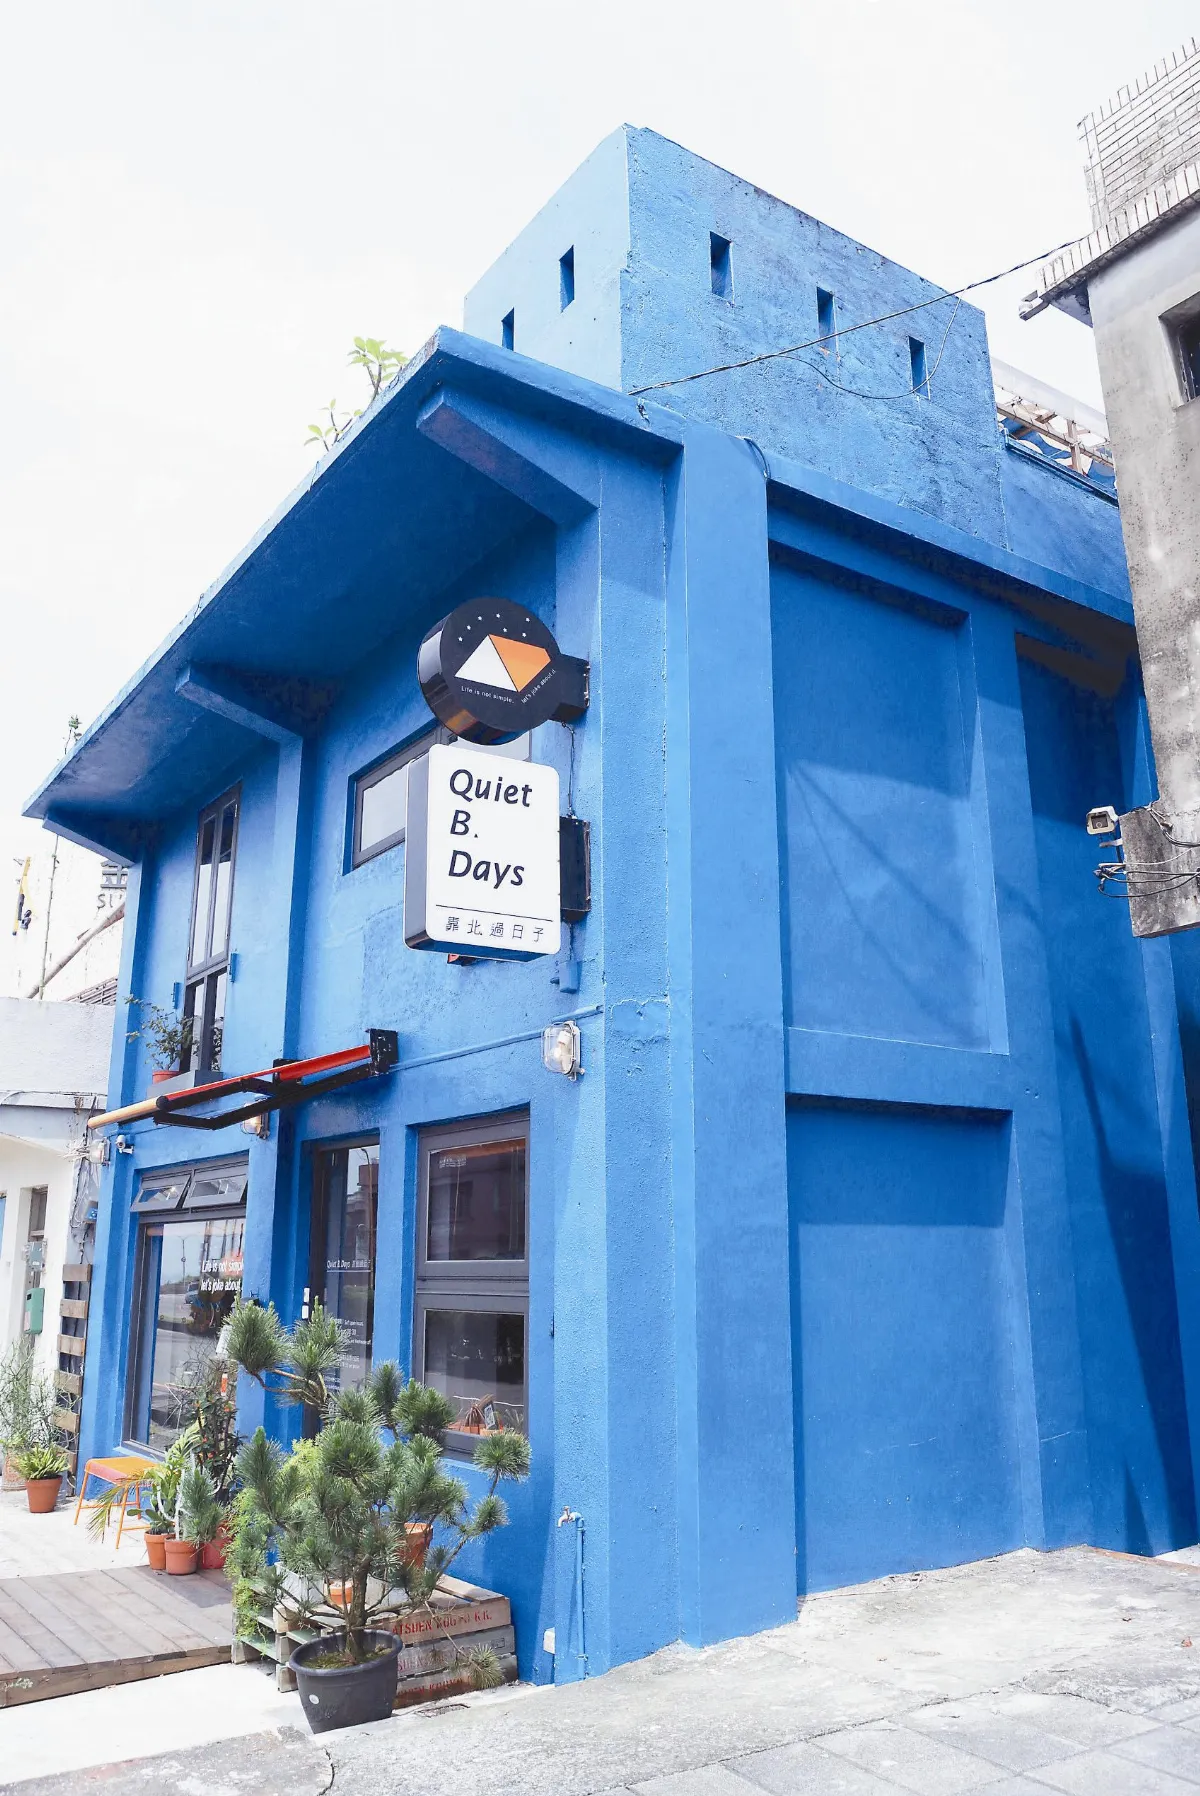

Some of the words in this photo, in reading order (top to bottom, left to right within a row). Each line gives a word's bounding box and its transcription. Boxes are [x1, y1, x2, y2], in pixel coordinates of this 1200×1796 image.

[461, 685, 473, 694] Life
[449, 768, 533, 808] Quiet
[449, 809, 479, 838] B.
[448, 849, 525, 890] Days
